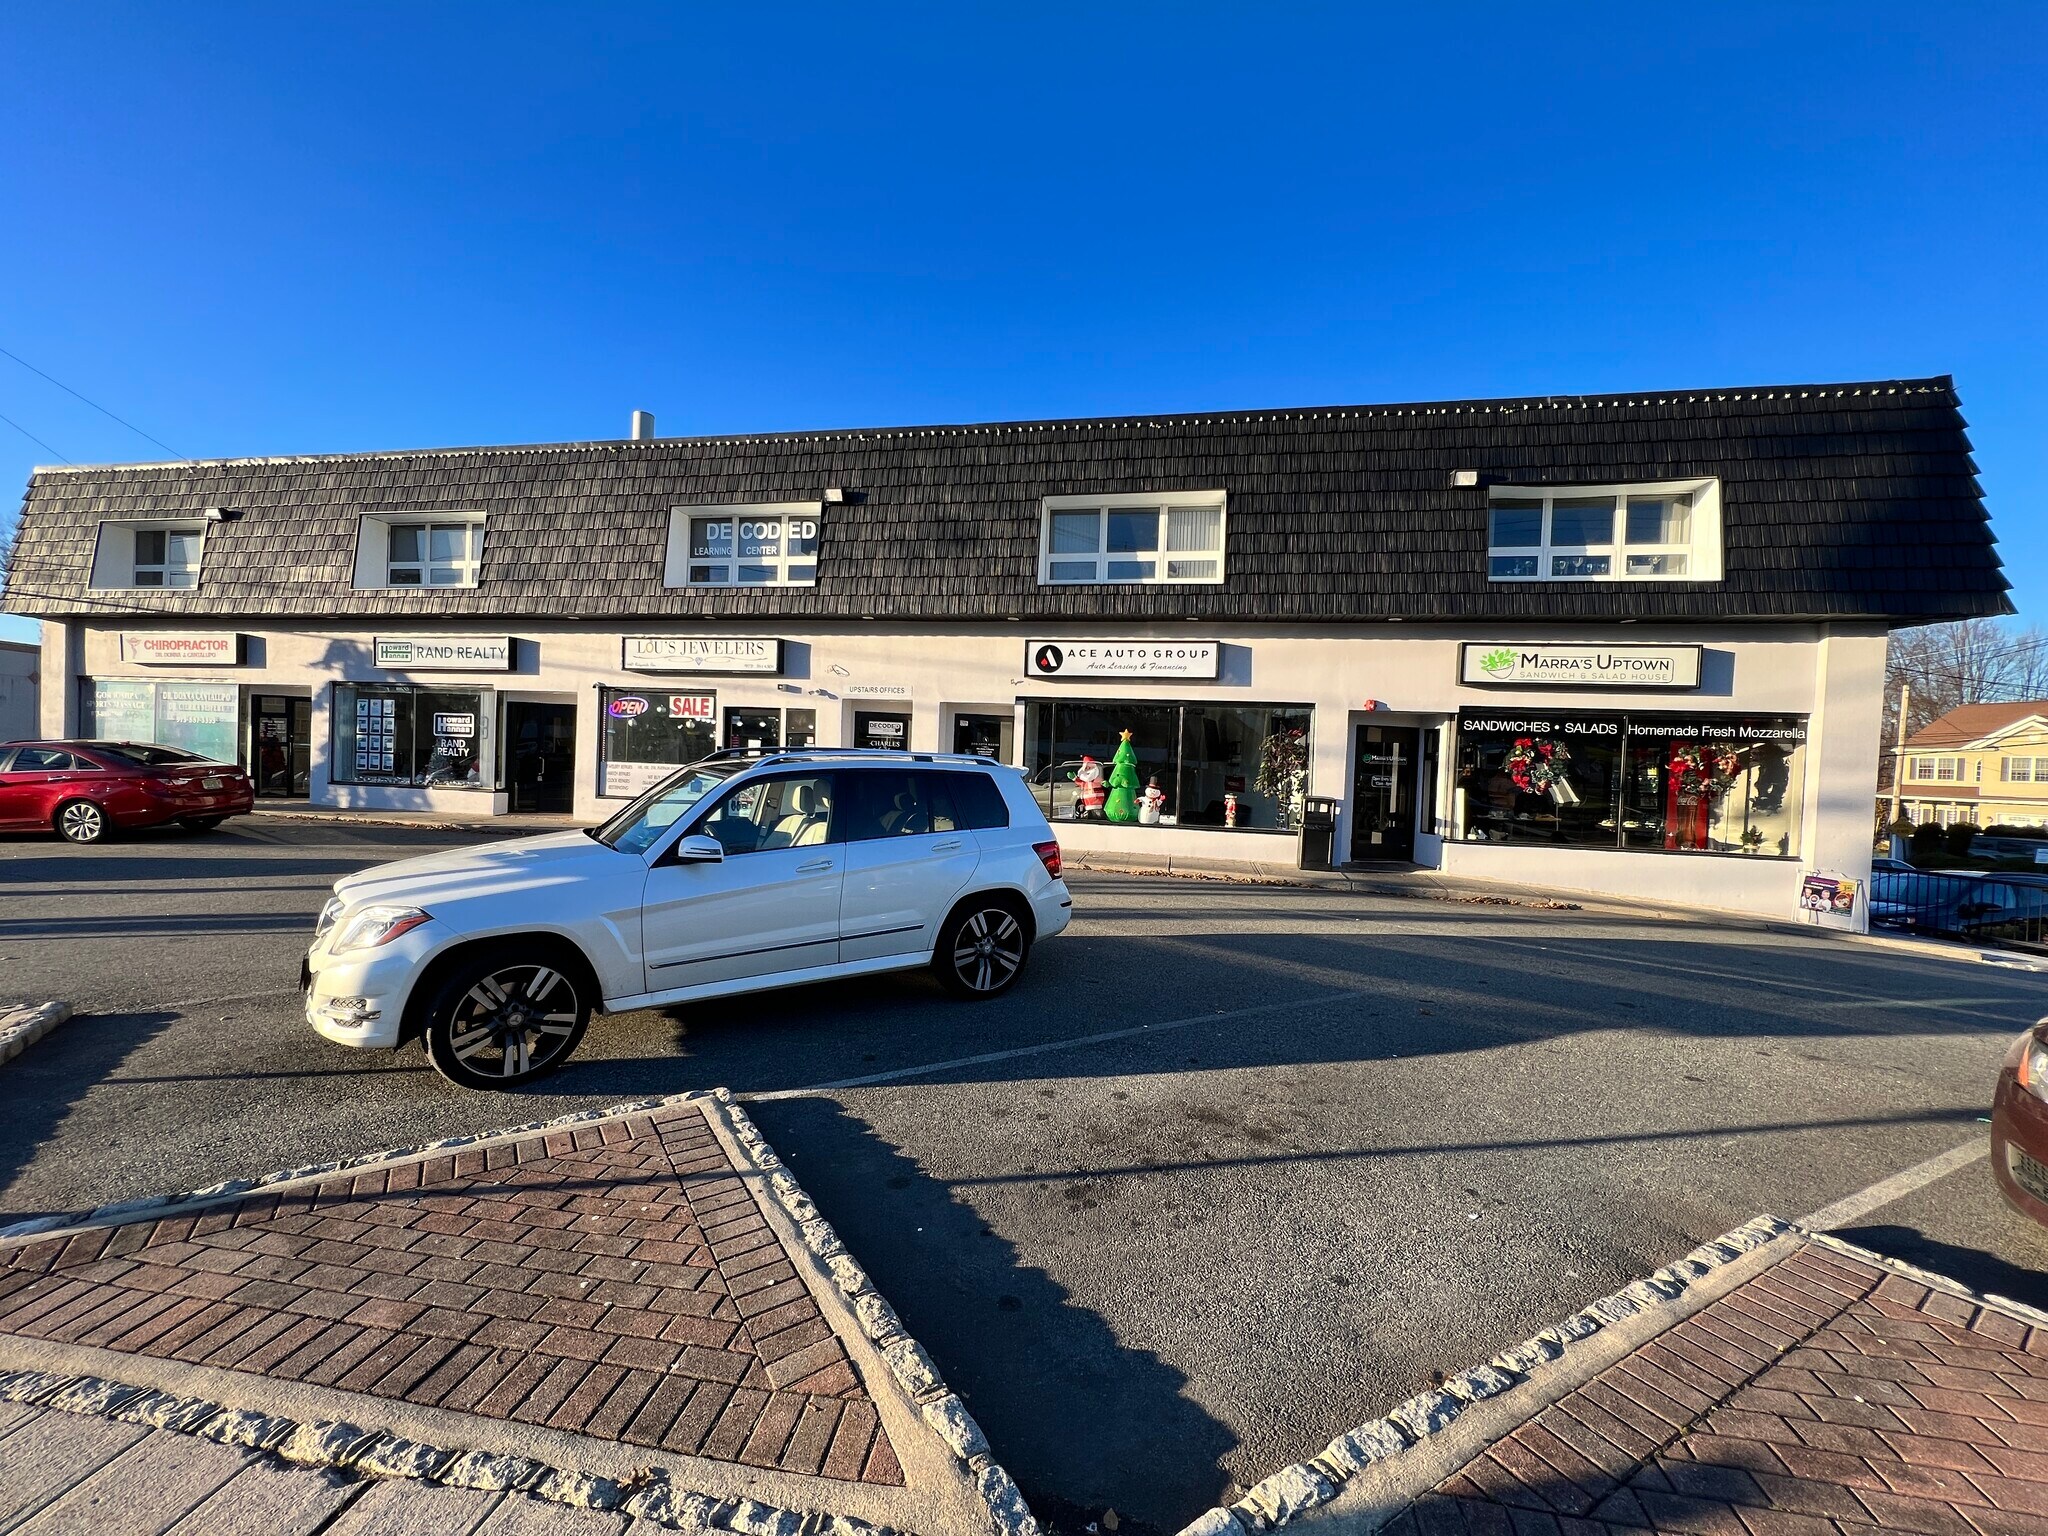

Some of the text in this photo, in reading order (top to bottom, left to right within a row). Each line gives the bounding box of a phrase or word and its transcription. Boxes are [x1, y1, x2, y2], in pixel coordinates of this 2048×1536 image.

[694, 546, 777, 555] LEARNING CENTER
[143, 640, 228, 650] CHIROPRACTOR
[637, 640, 765, 655] LOU'S JEWELERS
[416, 646, 507, 659] RAND REALTY
[1067, 649, 1209, 659] ACE AUTO GROUP
[1086, 662, 1106, 670] Auto
[1107, 662, 1138, 672] Leasing
[1149, 662, 1188, 672] Financing
[1520, 671, 1575, 679] SANDWICH
[1631, 673, 1668, 681] HOUSE
[849, 686, 905, 694] UPSTAIRS OFFICES
[611, 700, 645, 715] OPEN
[672, 697, 710, 716] SALE
[1463, 720, 1618, 735] SANDWICHES SALADS
[1628, 724, 1806, 740] Homemade Fresh Mozzarella
[440, 739, 466, 748] RAND
[437, 747, 470, 757] REALTY
